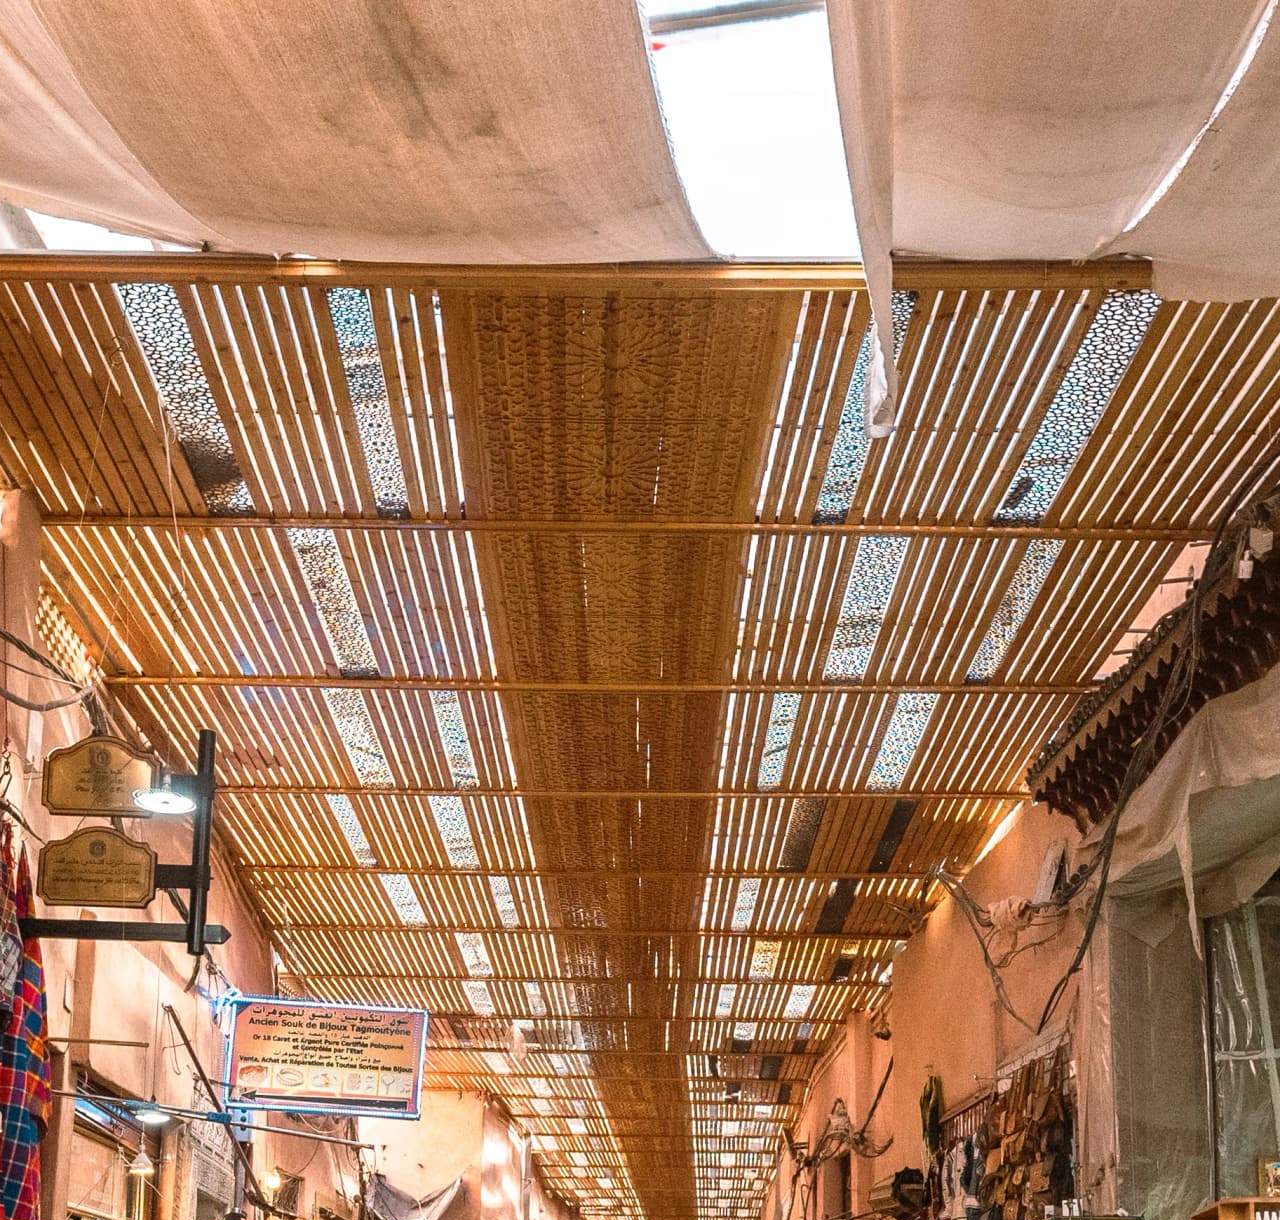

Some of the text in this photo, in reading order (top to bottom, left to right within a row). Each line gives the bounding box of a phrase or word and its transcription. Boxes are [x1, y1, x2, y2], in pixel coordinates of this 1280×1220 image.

[249, 1017, 279, 1026] Ancien
[281, 1019, 304, 1028] Souk
[306, 1021, 317, 1029] de
[319, 1021, 347, 1032] Bijoux
